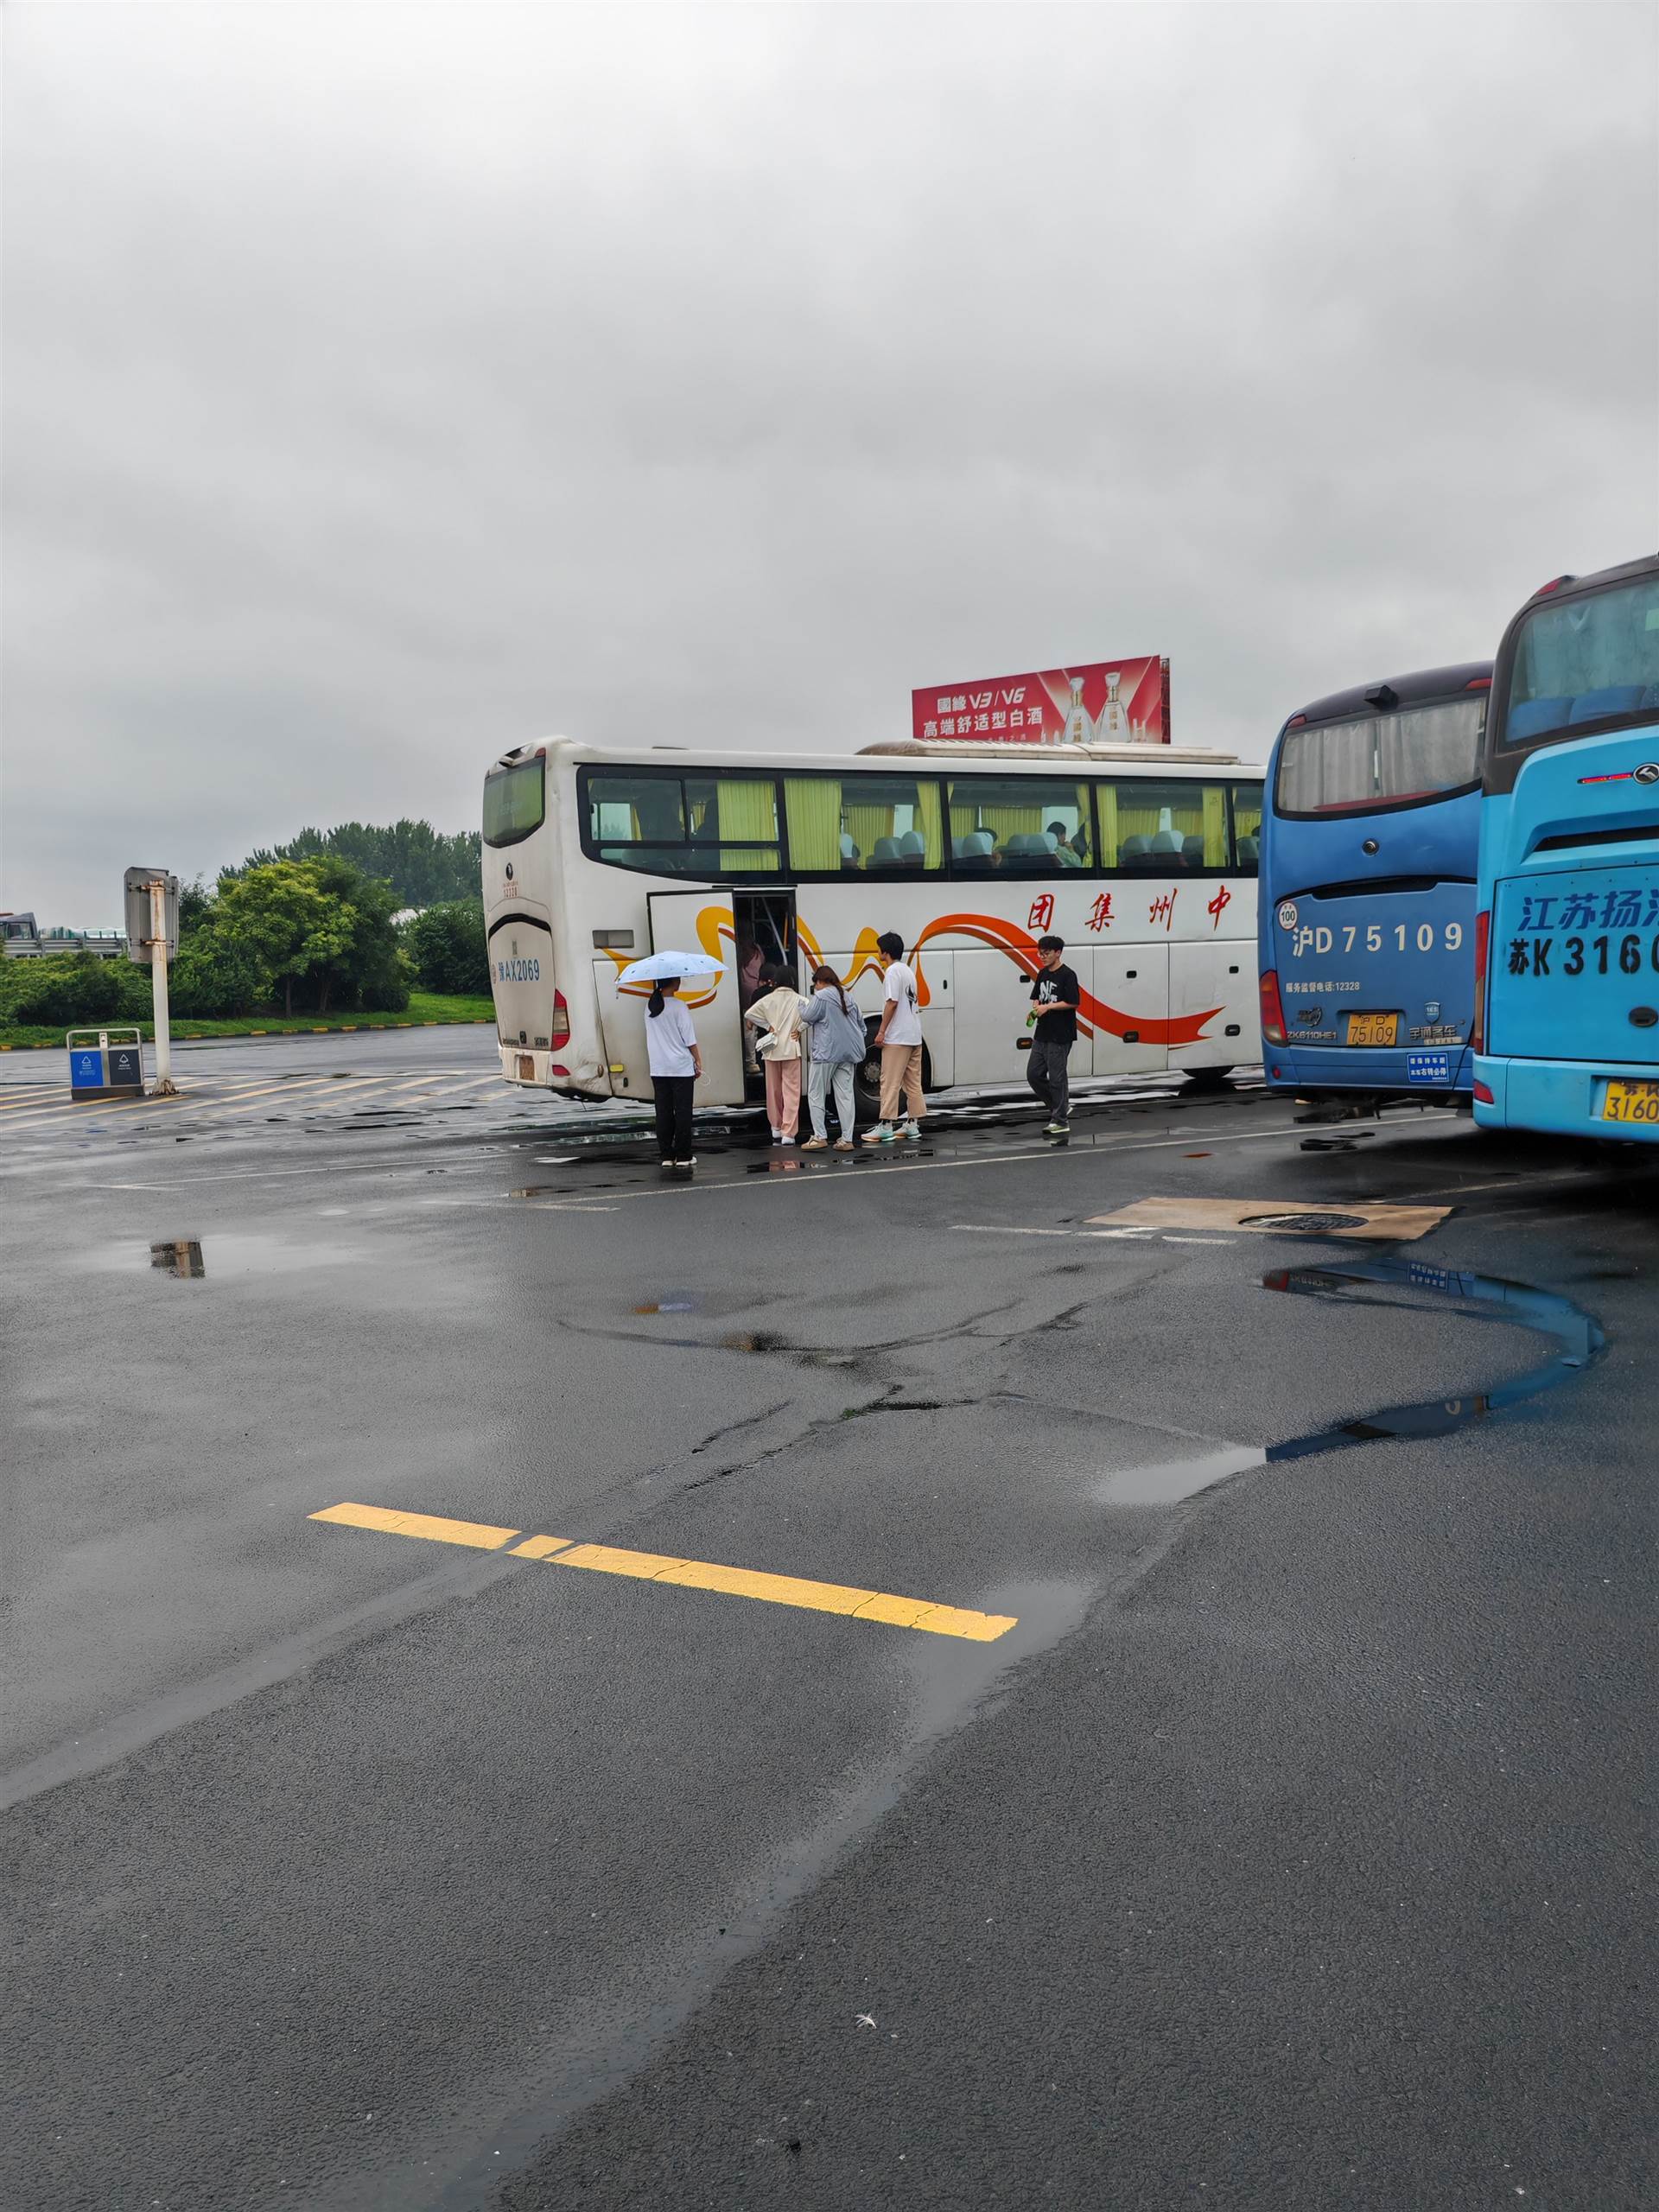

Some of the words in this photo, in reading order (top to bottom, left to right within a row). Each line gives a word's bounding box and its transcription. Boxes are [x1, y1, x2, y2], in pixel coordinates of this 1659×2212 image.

[923, 706, 1043, 738] 高端舒适型白酒
[1281, 911, 1295, 922] 100
[1350, 1026, 1393, 1043] 75109
